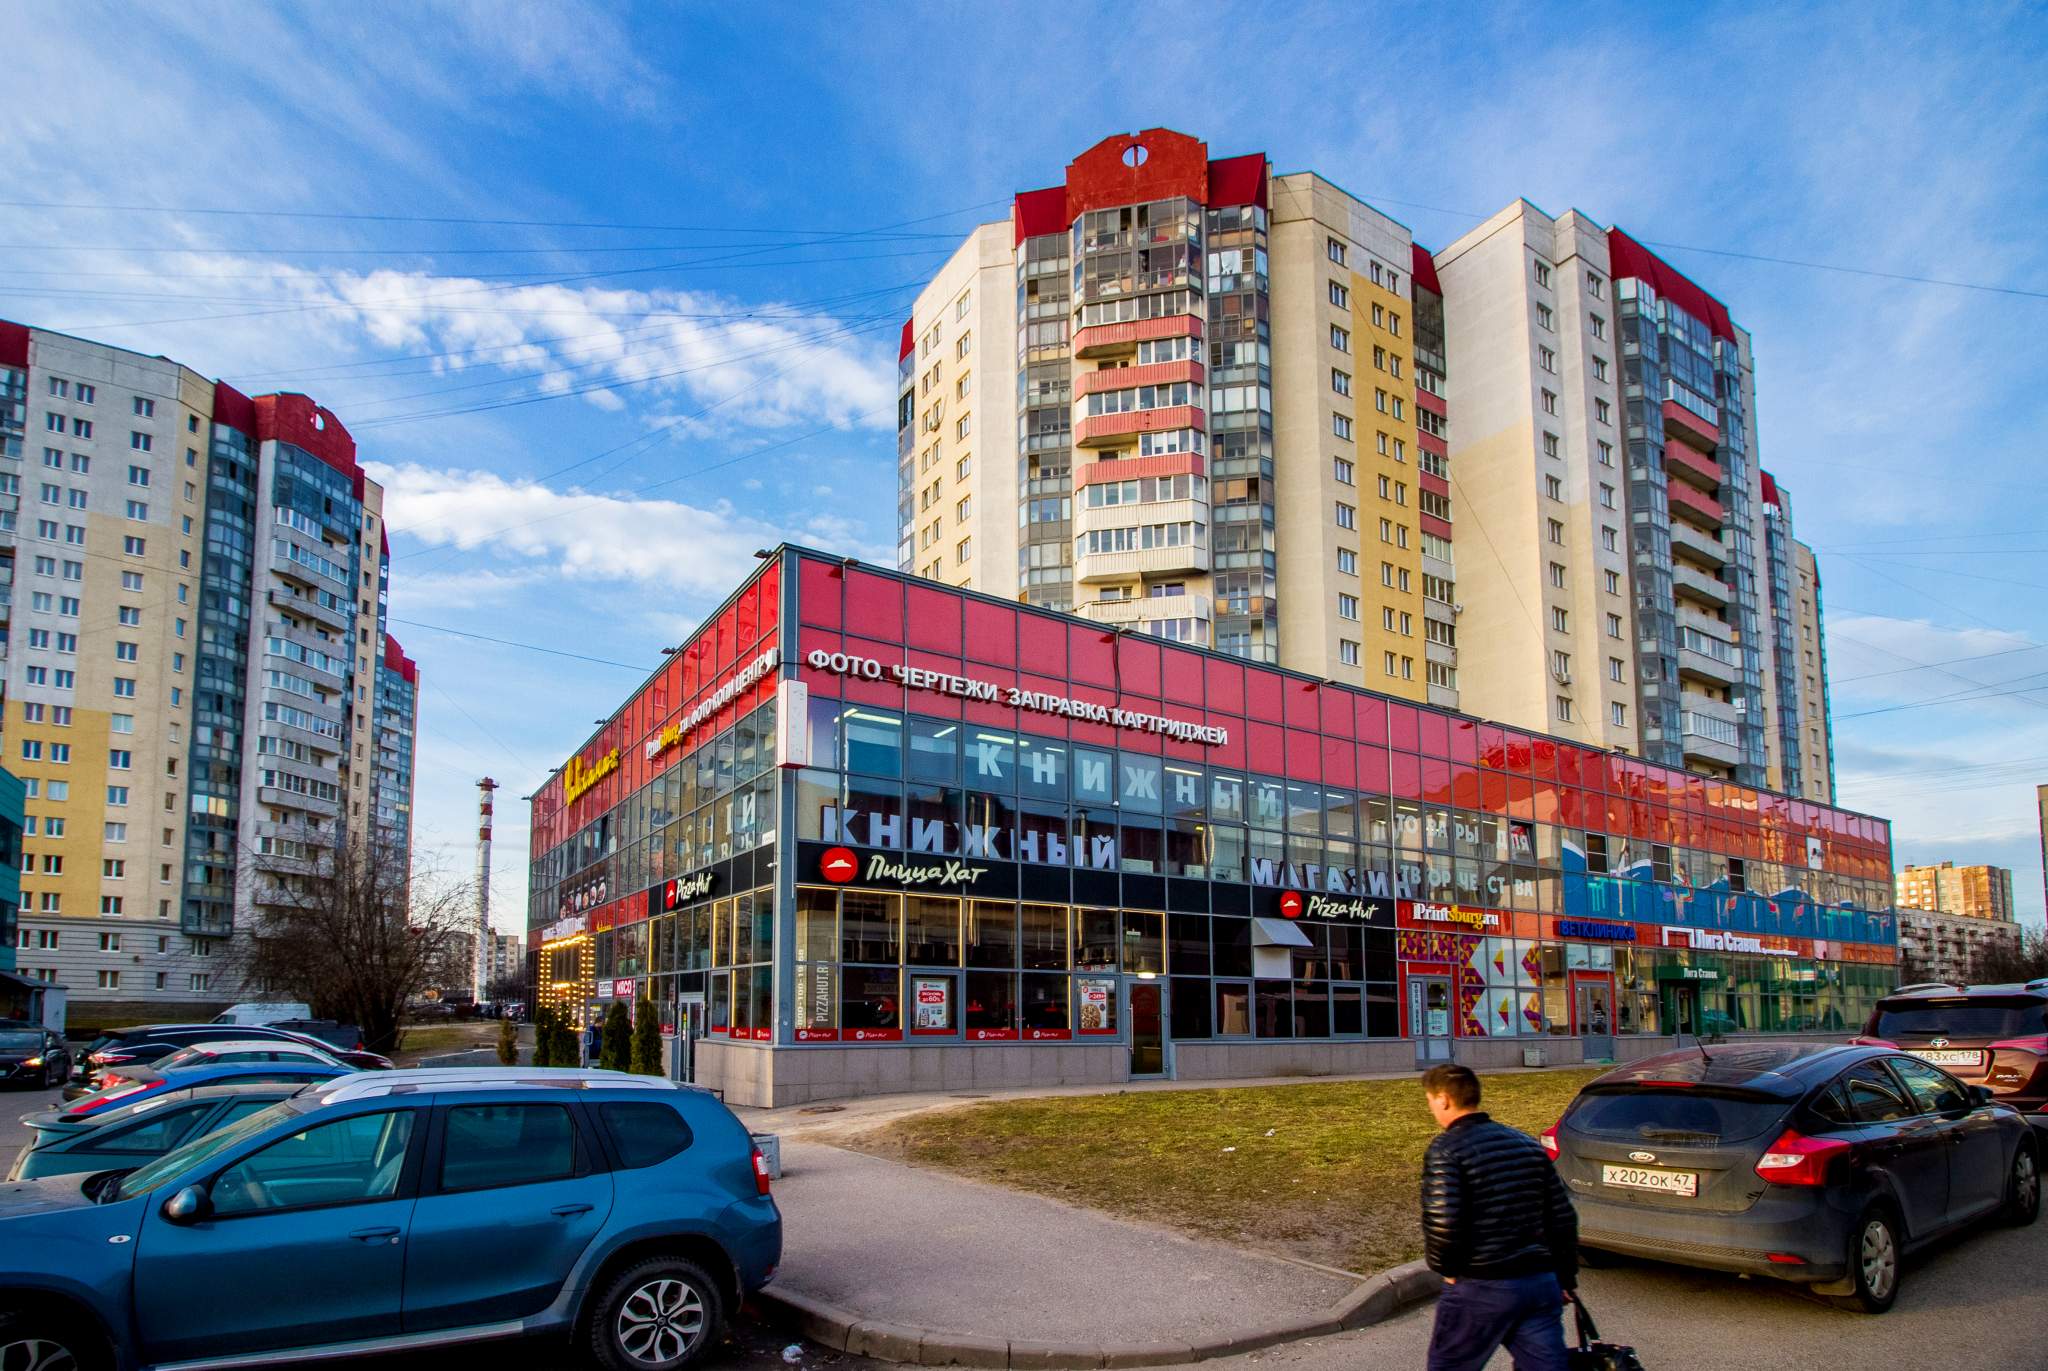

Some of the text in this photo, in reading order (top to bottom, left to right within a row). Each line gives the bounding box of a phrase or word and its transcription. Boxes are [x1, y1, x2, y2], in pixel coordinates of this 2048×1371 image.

[892, 663, 998, 701] ЧЕРТЕЖИ
[1007, 687, 1110, 723] ЗАПРАВКА
[1111, 709, 1228, 745] КАРТРИДЖЕЙ
[978, 742, 1276, 817] КНИЖНЫЙ
[823, 806, 1115, 869] КНИЖНЫЙ
[866, 854, 989, 885] Пицца Хат
[676, 873, 713, 903] Pizza Hut
[1307, 895, 1379, 920] Pizza Hut
[1561, 920, 1636, 940] ВЕТКЛИНИКА
[1696, 929, 1761, 953] Лига Ставок
[1674, 1174, 1690, 1186] 47
